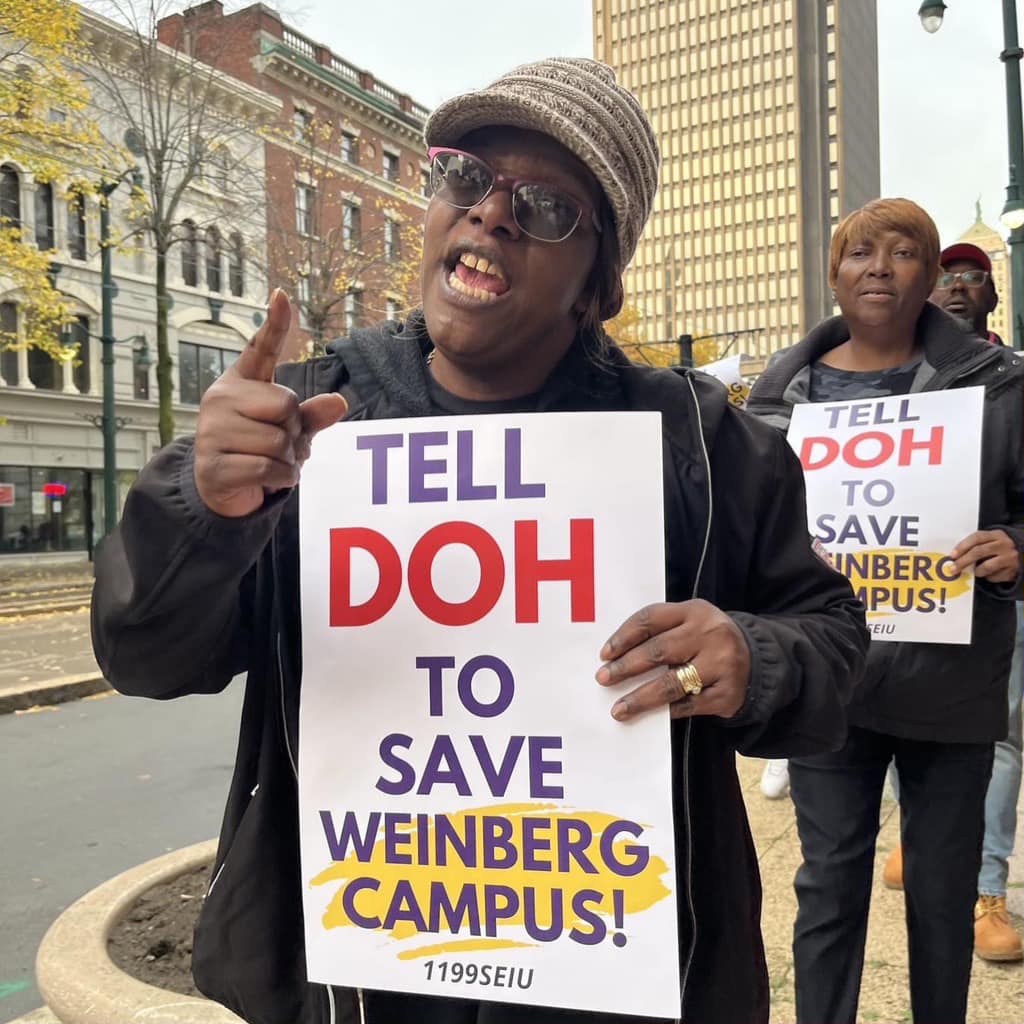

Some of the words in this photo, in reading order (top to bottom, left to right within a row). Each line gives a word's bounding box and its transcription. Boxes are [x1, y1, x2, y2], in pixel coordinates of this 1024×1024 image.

[824, 399, 920, 429] TELL
[356, 428, 546, 505] TELL
[800, 426, 944, 472] DOH
[841, 479, 895, 507] TO
[815, 514, 919, 547] SAVE
[329, 518, 596, 628] DOH
[416, 655, 515, 718] TO
[375, 733, 565, 800] SAVE
[319, 810, 651, 877] WEINBERG
[342, 877, 628, 948] CAMPUS!
[423, 960, 535, 990] 1199SEIU
